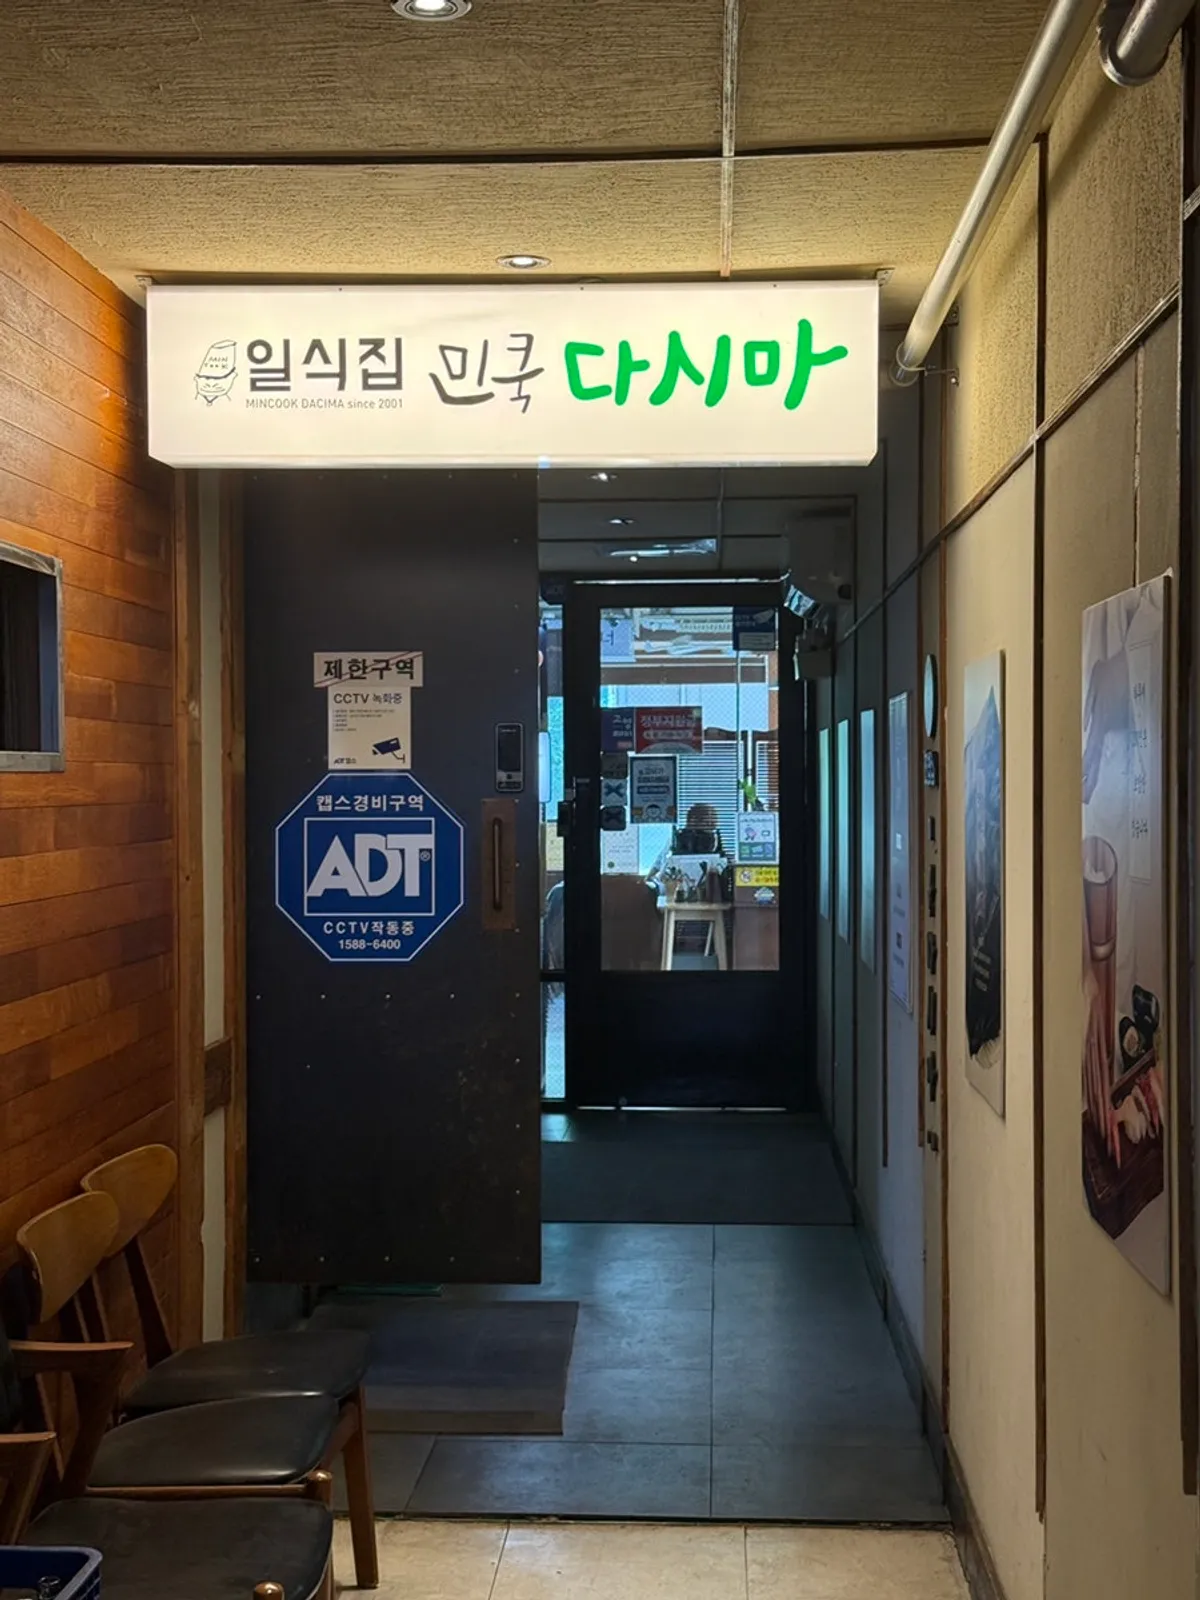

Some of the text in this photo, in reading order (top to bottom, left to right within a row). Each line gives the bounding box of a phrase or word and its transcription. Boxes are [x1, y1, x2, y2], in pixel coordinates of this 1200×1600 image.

[247, 318, 849, 414] 일식집 민쿡 다시마
[246, 398, 403, 409] MINCOOK DACIMA since 2001
[324, 658, 414, 680] 제한구역
[333, 692, 403, 704] CCTV 녹화중
[316, 794, 424, 812] 캡스경비구역
[307, 833, 433, 897] ADT
[338, 938, 402, 950] 1588-6400
